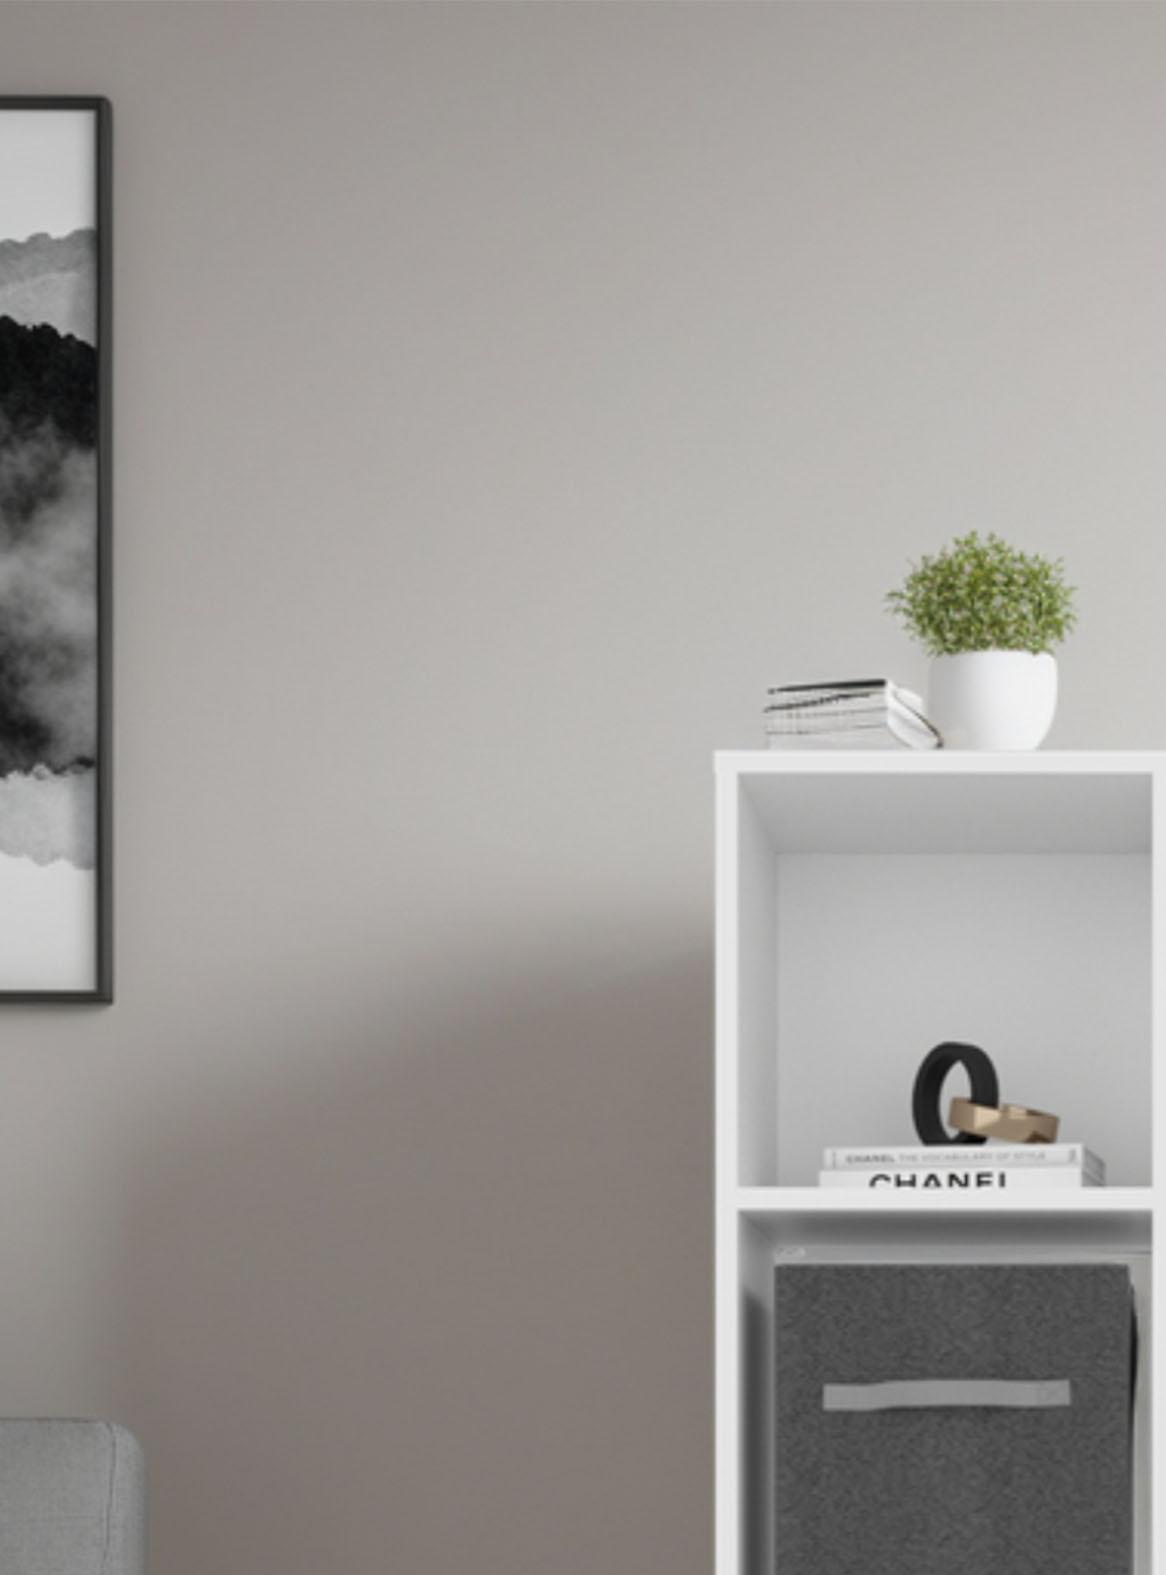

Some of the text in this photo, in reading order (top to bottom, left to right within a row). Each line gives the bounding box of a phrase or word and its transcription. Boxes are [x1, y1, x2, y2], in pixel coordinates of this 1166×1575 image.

[846, 1150, 1046, 1164] CHANEL THE VOCABULARY OF STYLE
